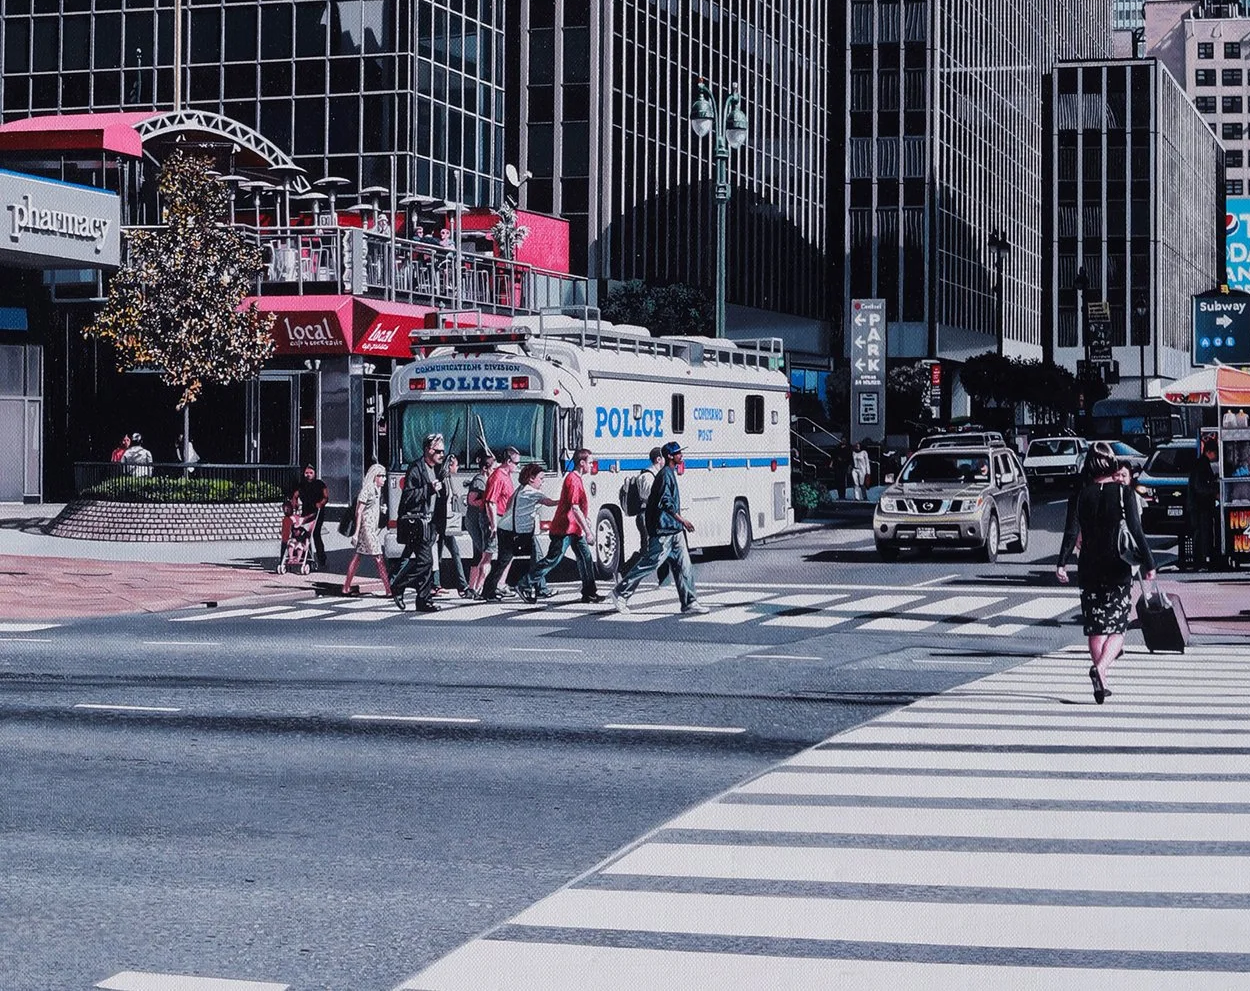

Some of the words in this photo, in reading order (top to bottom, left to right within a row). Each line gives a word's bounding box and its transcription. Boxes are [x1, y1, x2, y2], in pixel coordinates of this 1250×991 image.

[8, 193, 112, 251] pharmacy
[1200, 301, 1246, 315] Subway
[284, 317, 334, 340] local
[368, 323, 400, 343] local
[867, 313, 881, 372] PARK
[484, 364, 520, 372] DIVISION
[428, 377, 509, 391] POLICE
[595, 406, 664, 438] POLICE
[698, 429, 713, 441] POST
